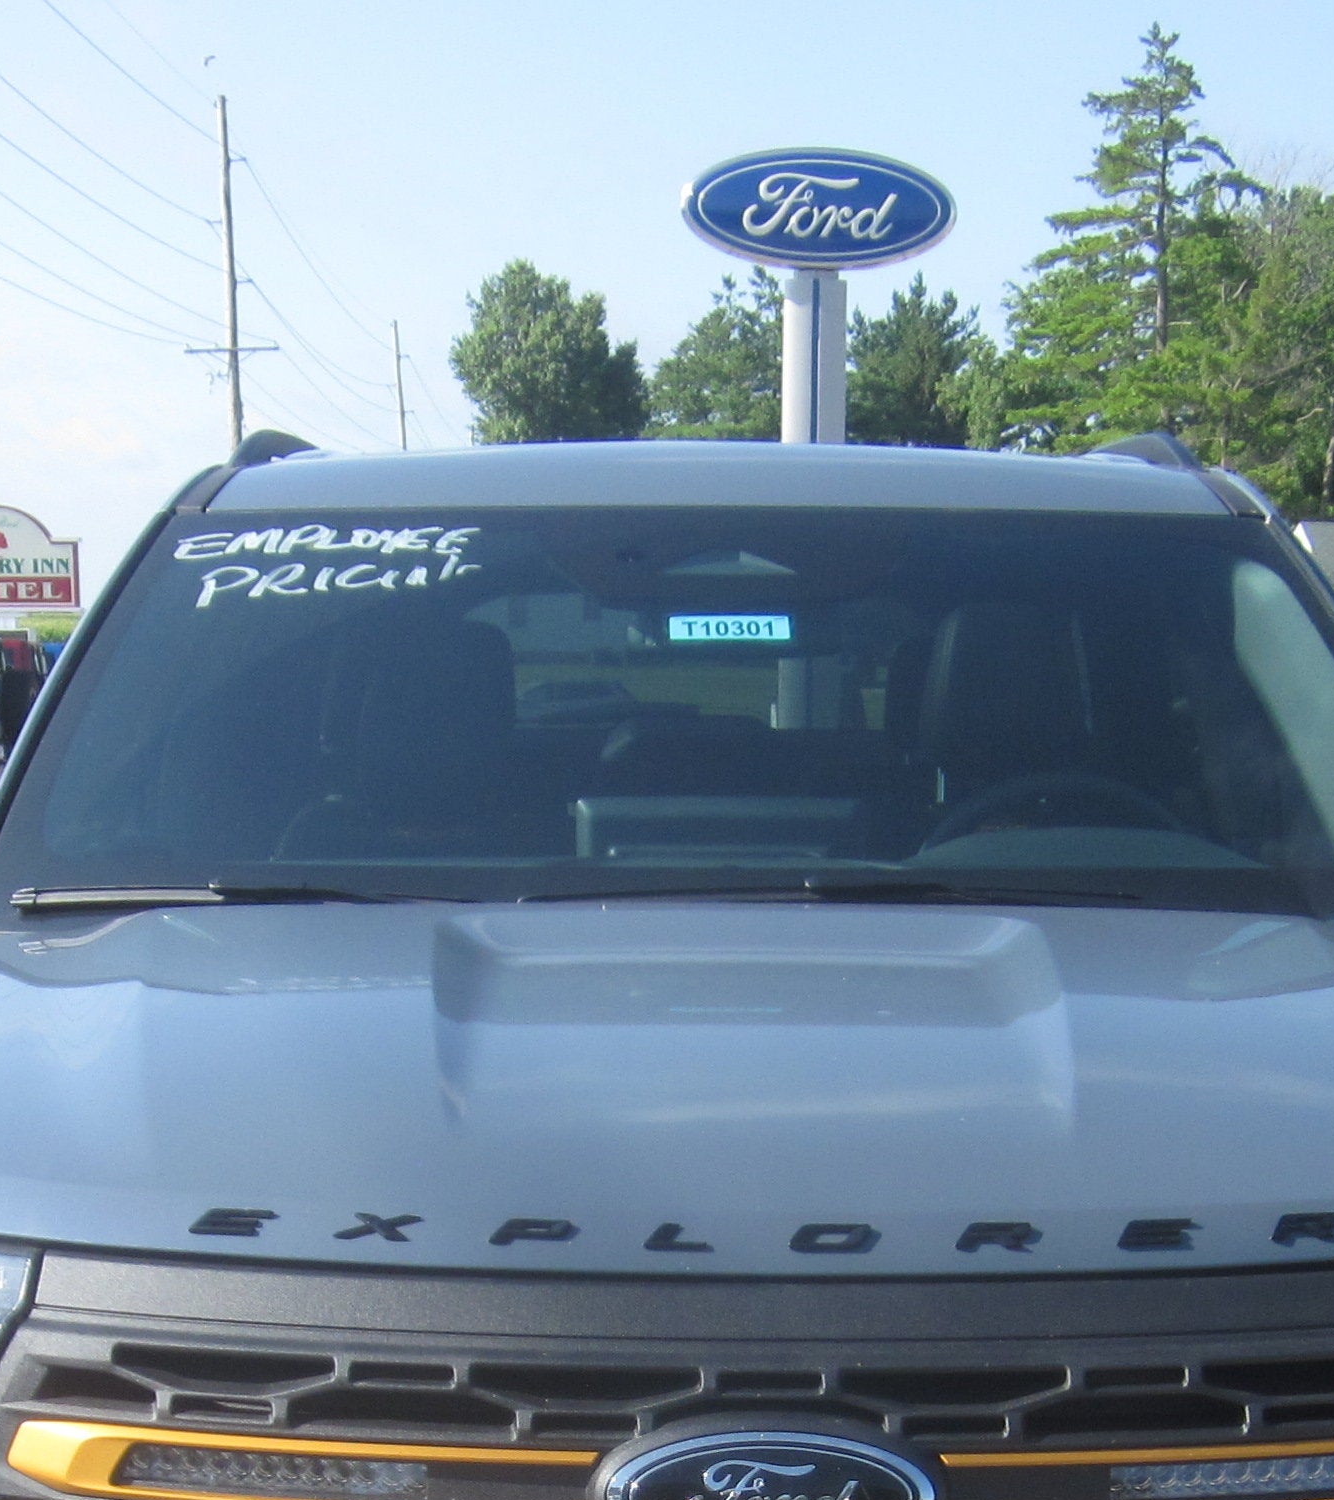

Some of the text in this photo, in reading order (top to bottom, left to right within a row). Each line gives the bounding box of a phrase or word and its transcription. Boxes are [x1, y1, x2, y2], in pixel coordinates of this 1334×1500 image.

[742, 172, 898, 240] Ford
[173, 524, 482, 560] EMPLOYEE
[33, 558, 71, 574] INN
[681, 621, 774, 637] T10301
